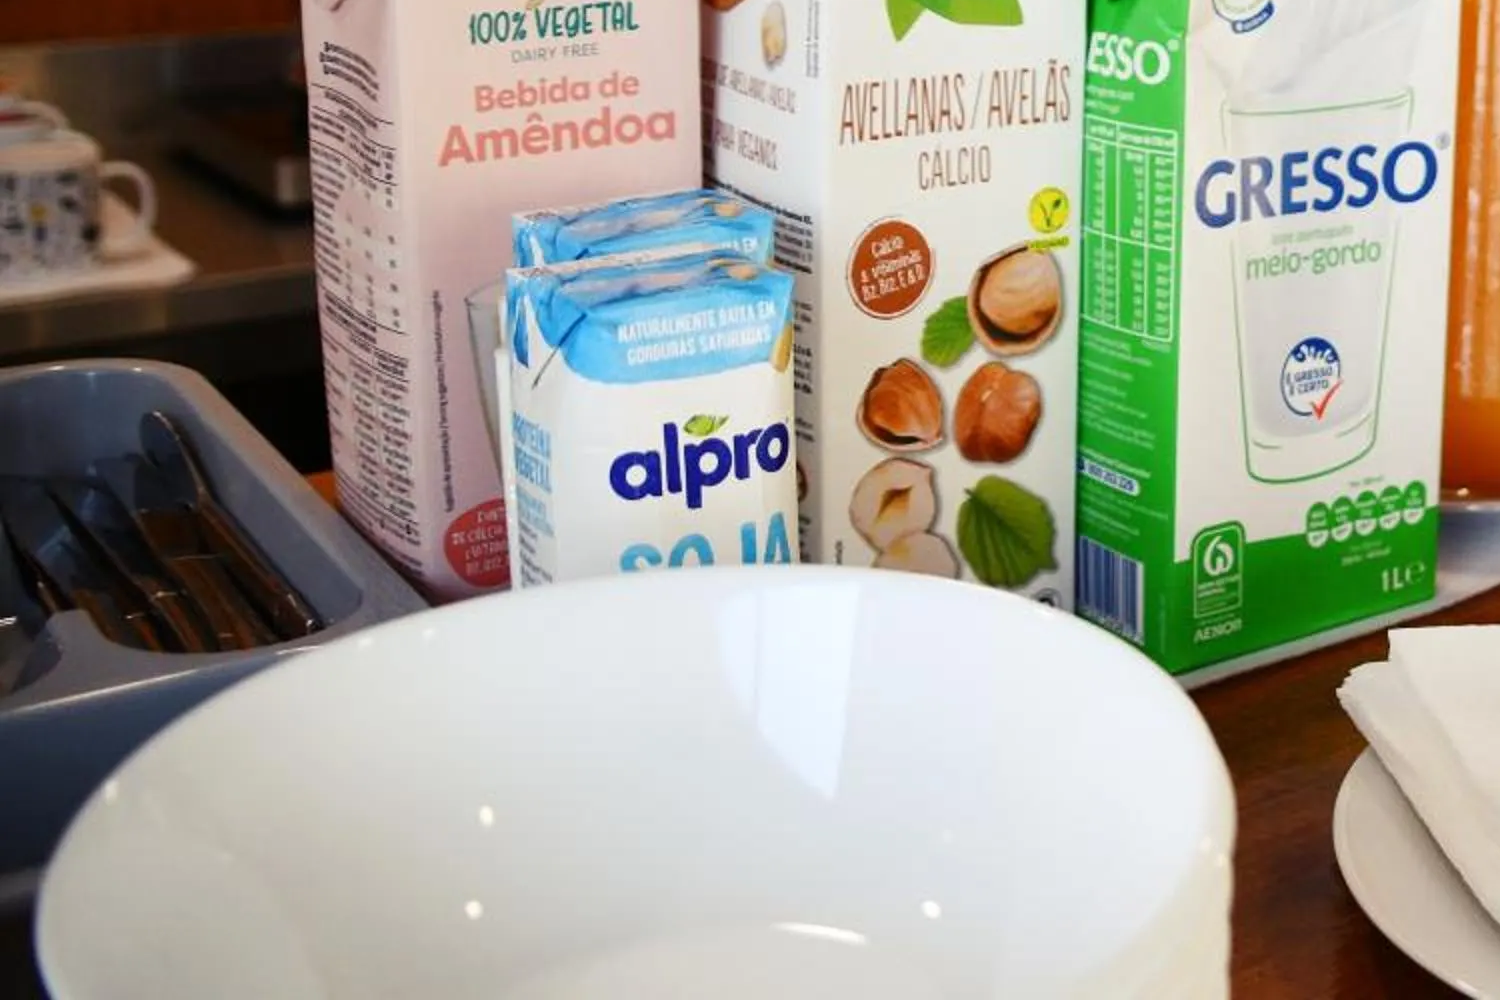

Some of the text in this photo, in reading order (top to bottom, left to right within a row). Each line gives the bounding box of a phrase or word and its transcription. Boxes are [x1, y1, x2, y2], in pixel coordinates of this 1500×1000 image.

[469, 1, 640, 44] 100% VEGETAL
[511, 43, 600, 64] DAIRY FREE
[474, 70, 640, 112] Bebida de
[839, 72, 966, 146] AVELLANAS
[987, 58, 1071, 129] AVELÃS
[438, 106, 676, 168] Amêndoa
[1194, 141, 1438, 228] GRESSO
[1246, 239, 1382, 280] meio-gordo
[617, 309, 716, 344] NATURALMENTE
[756, 299, 777, 318] EM
[627, 324, 772, 366] GORDURAS SATURADAS
[609, 422, 789, 510] alpro
